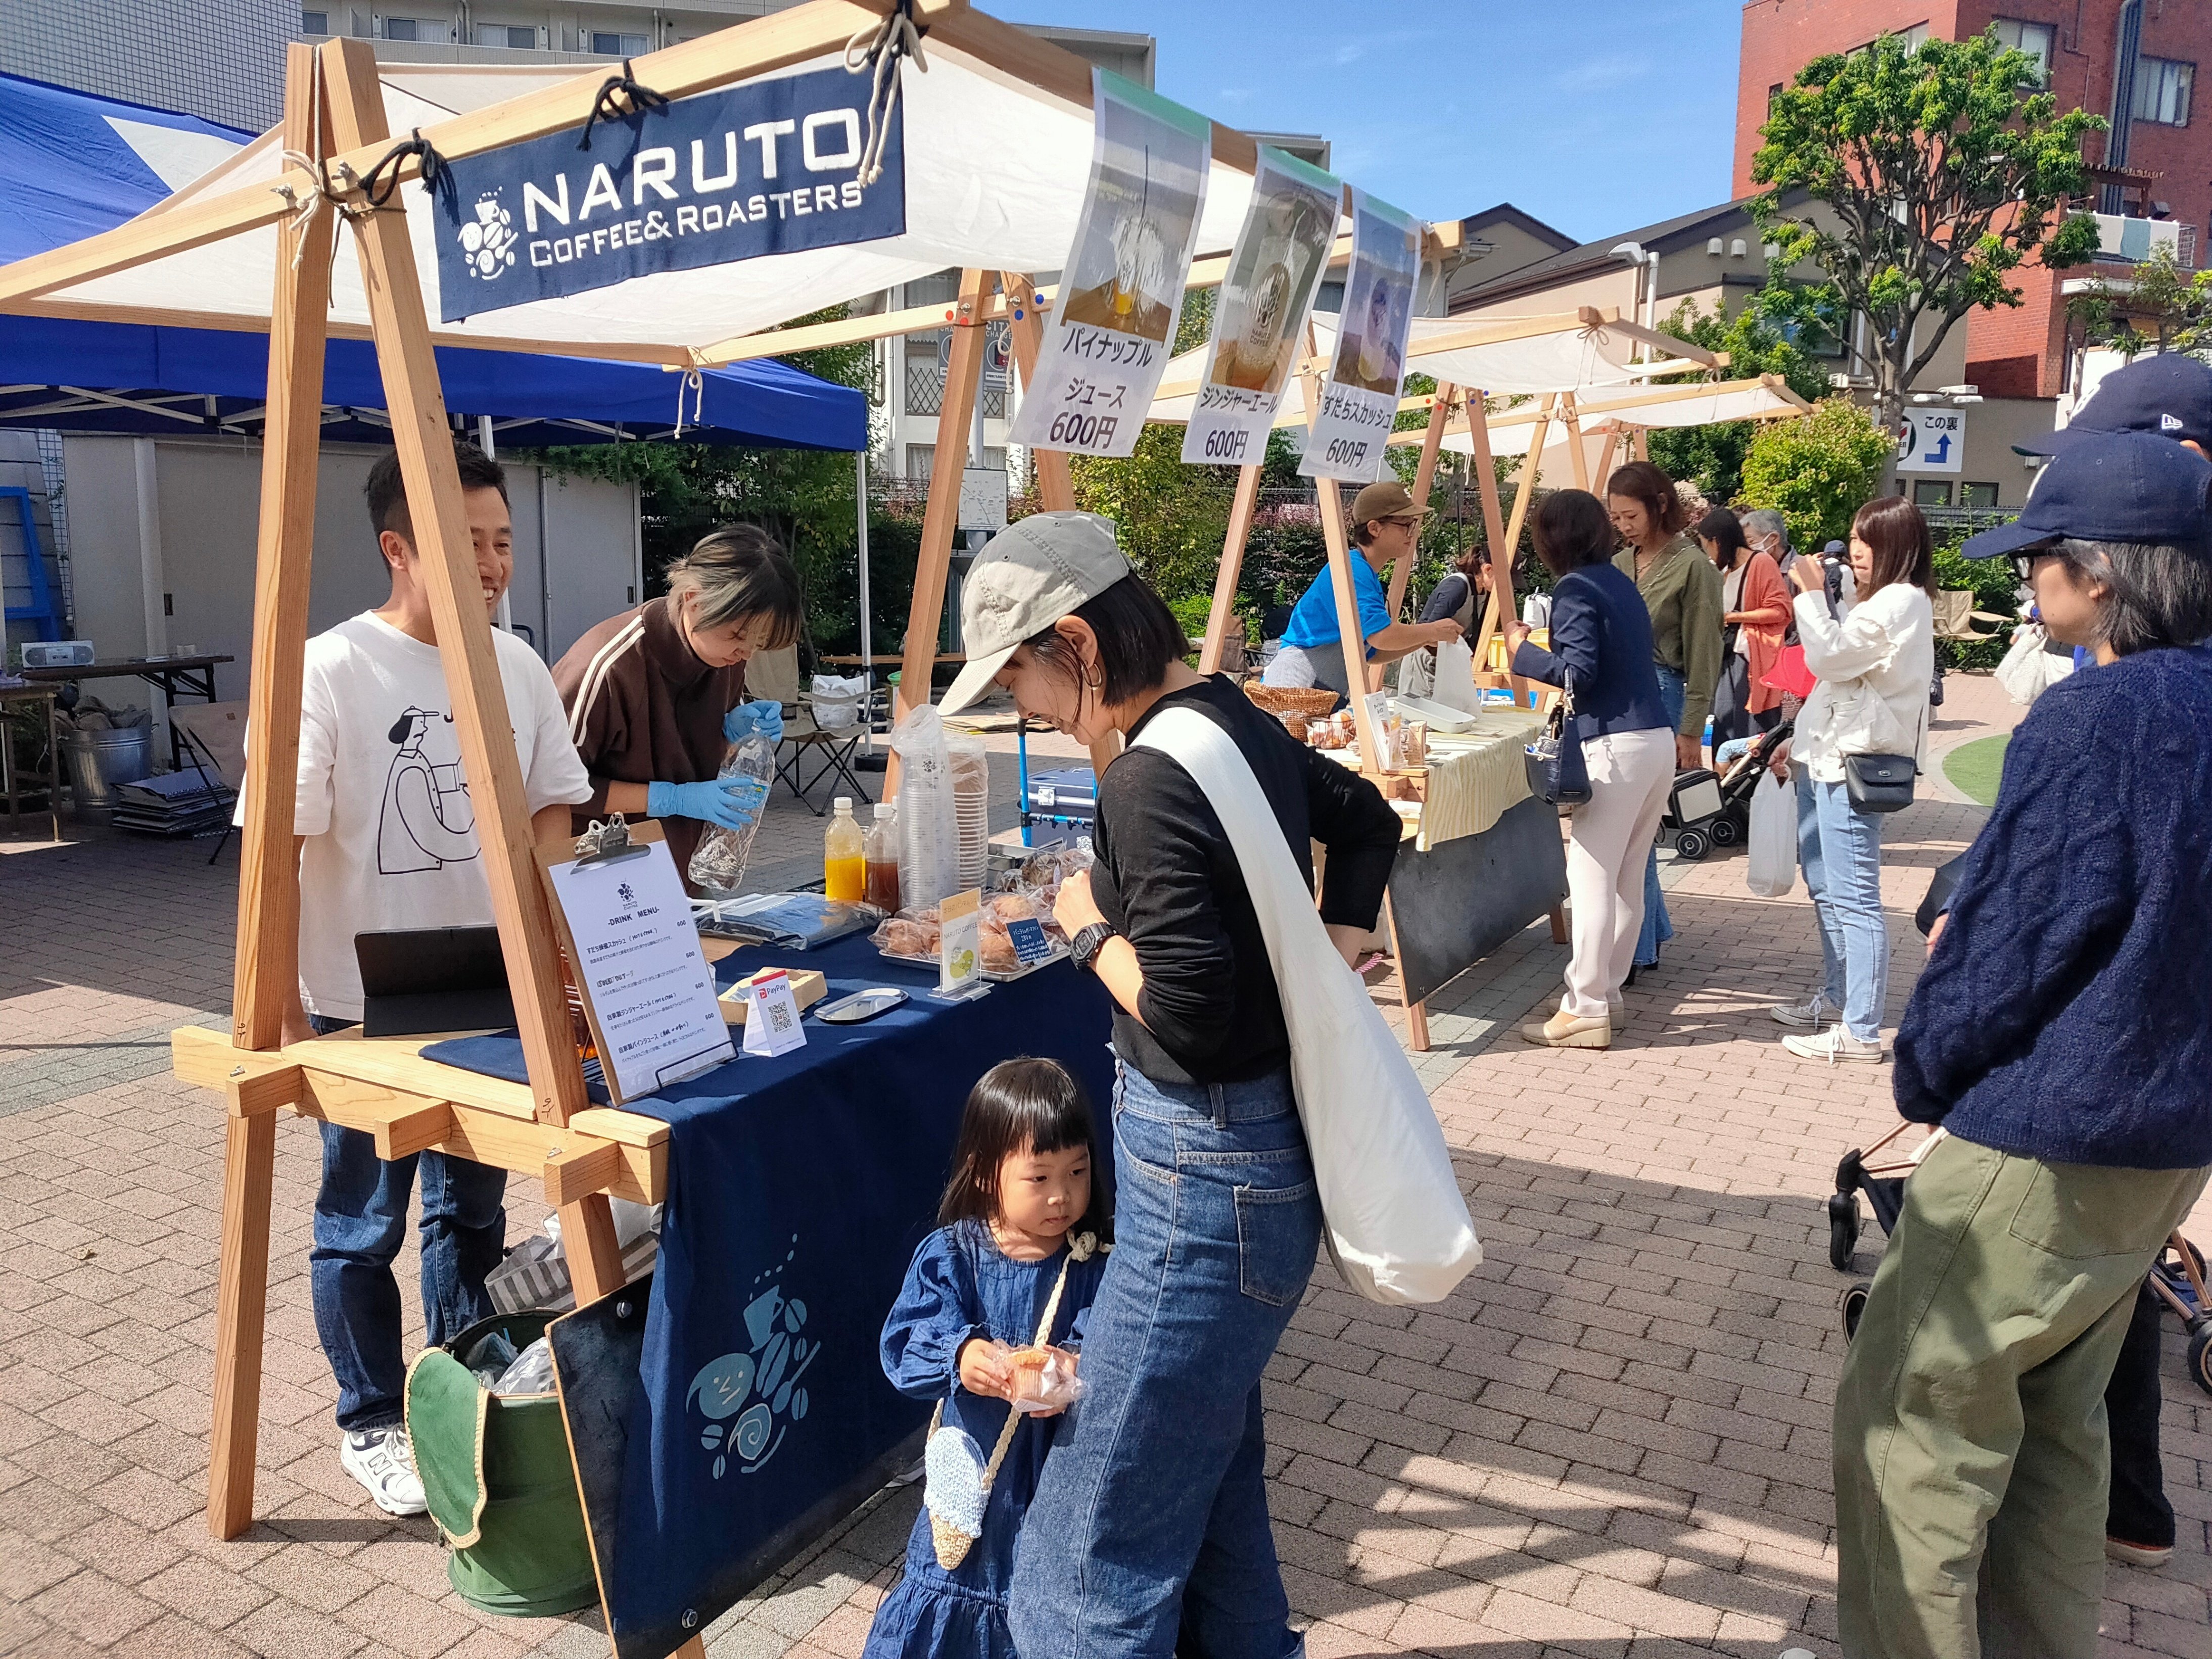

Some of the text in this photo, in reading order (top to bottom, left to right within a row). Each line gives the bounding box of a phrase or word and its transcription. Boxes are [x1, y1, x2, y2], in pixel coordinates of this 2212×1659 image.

[524, 108, 861, 232] NARUTO
[1063, 327, 1152, 367] パイナップル
[1065, 377, 1126, 409] ジュース
[1200, 386, 1278, 414] ジンジャーエール
[1323, 395, 1392, 429] すだちスカッシュ
[1925, 416, 1958, 431] この裏
[1050, 412, 1118, 449] 600円
[1205, 430, 1249, 459] 600円
[1326, 438, 1368, 467] 600円
[944, 922, 977, 939] NARUTO COFFEE
[767, 983, 786, 995] PayPay
